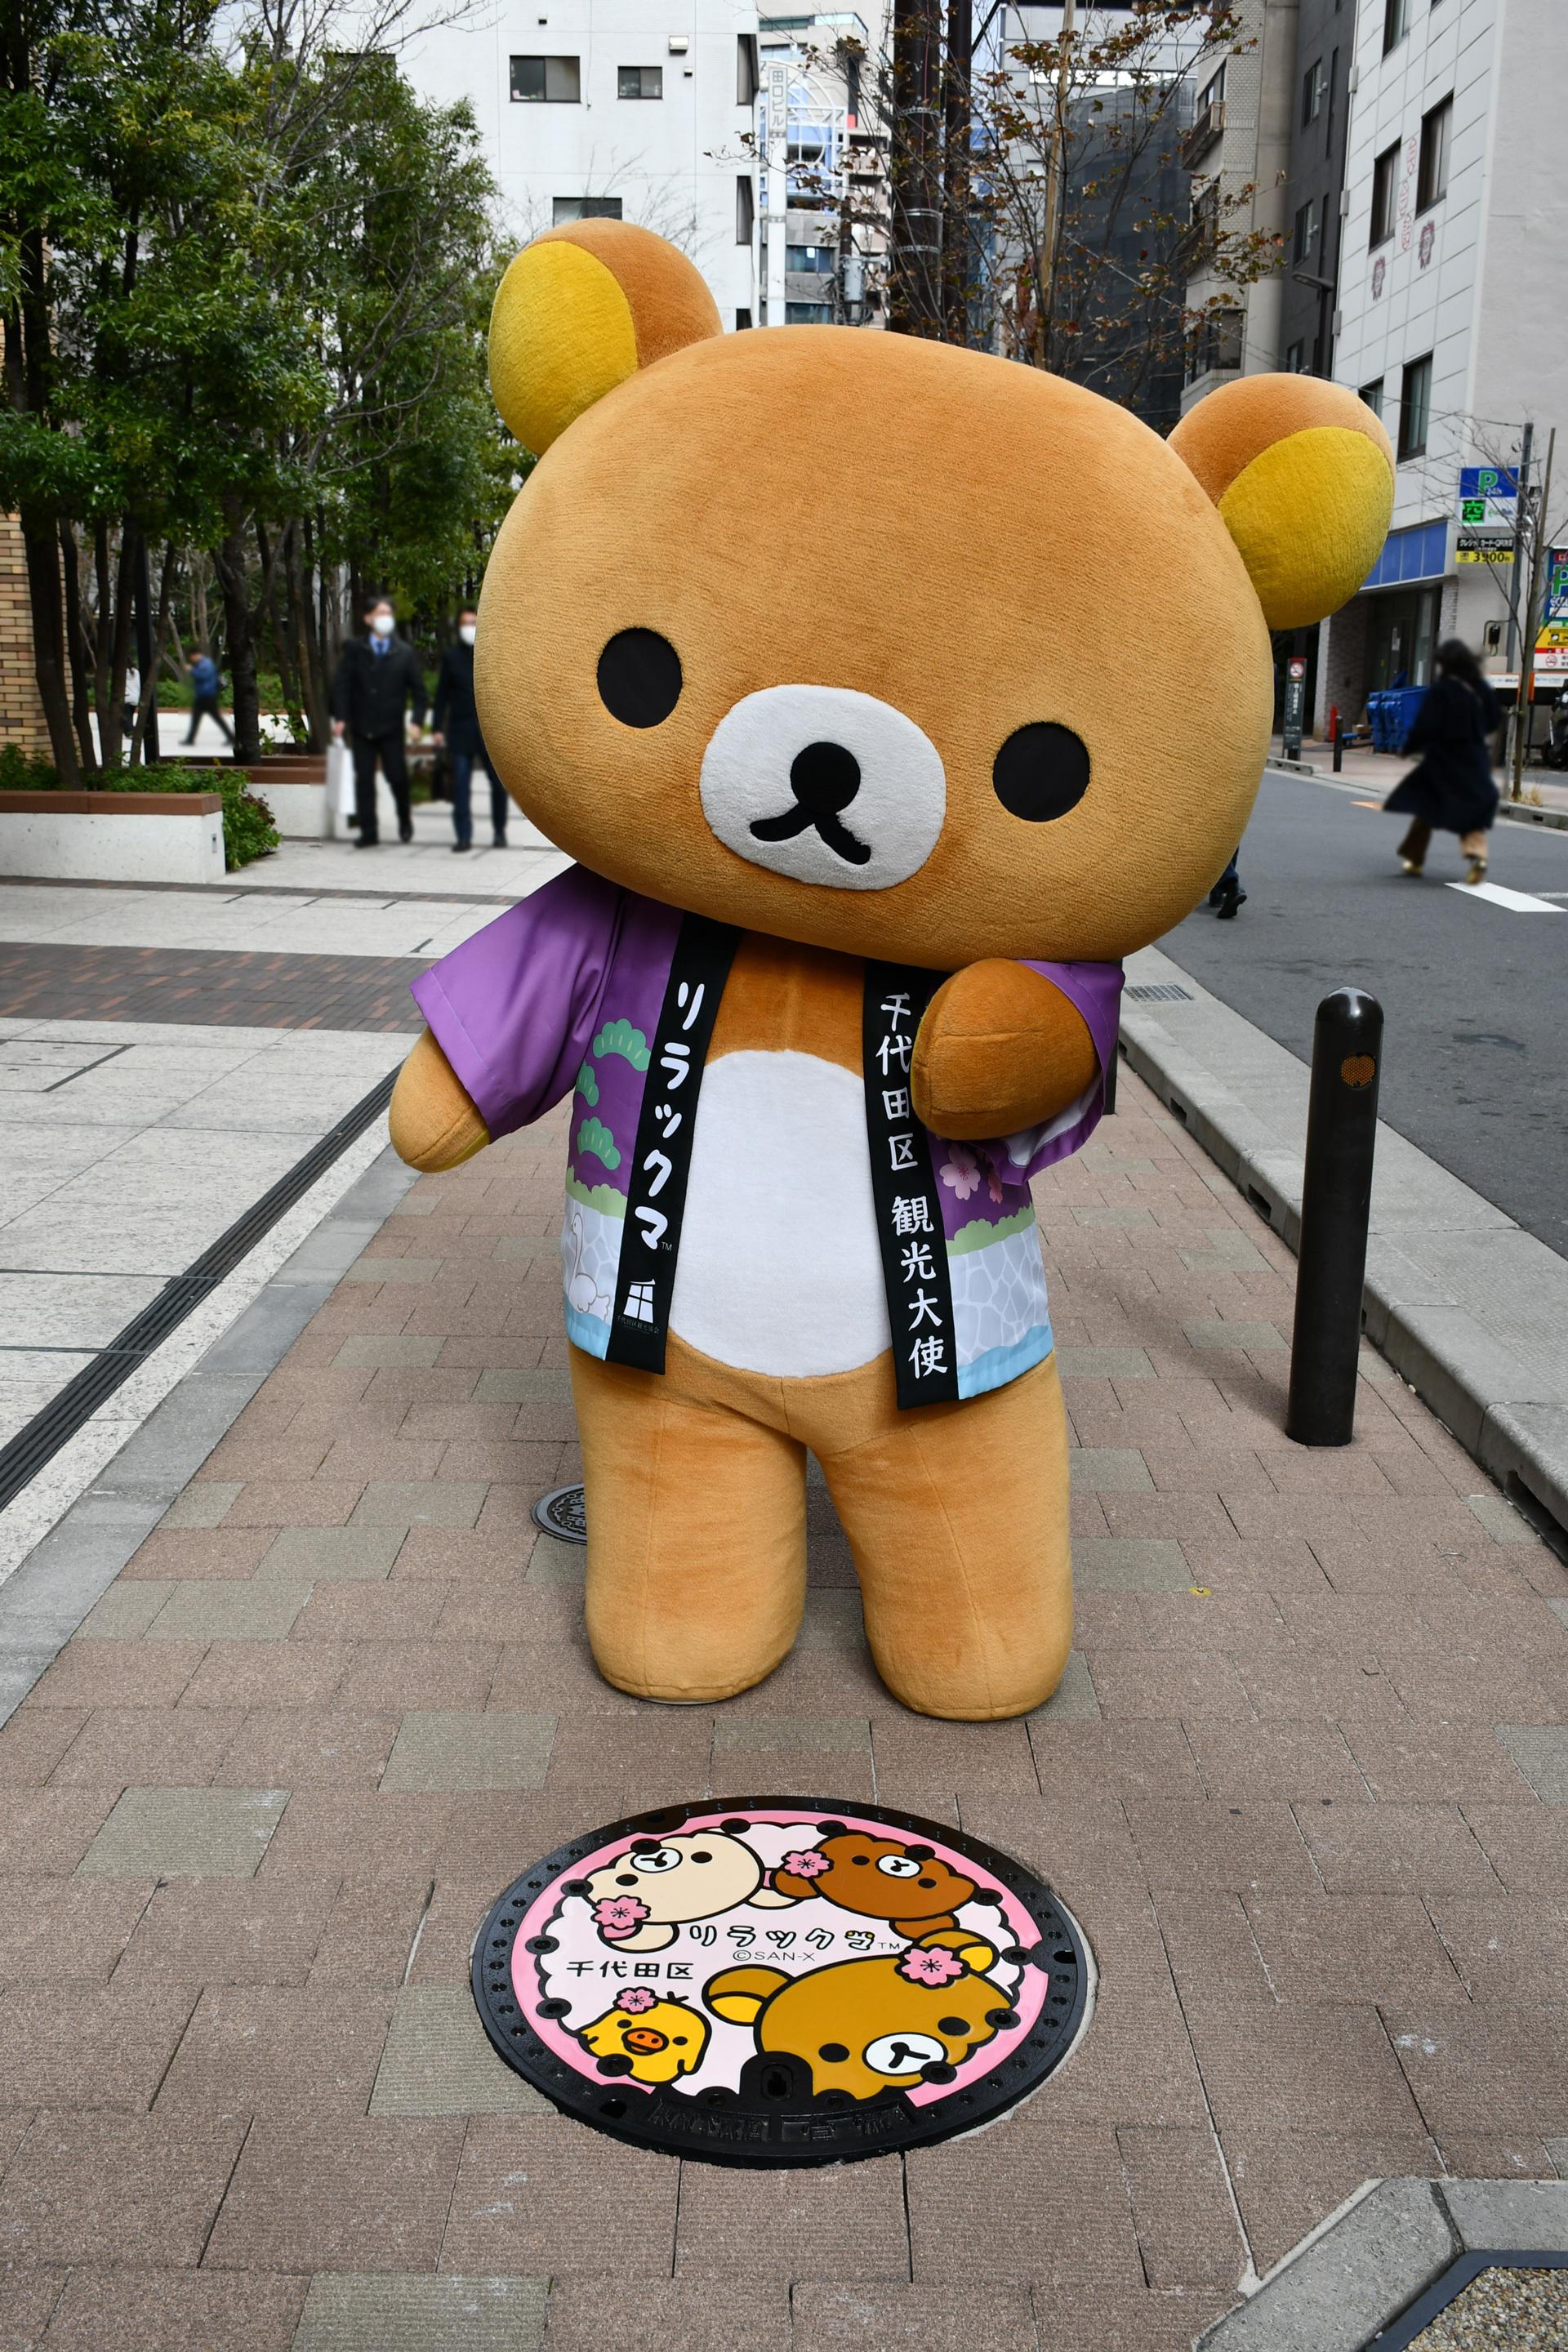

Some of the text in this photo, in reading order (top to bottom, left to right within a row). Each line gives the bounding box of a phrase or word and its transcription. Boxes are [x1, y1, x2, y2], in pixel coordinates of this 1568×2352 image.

[773, 70, 784, 126] 田口ビル
[1477, 470, 1499, 497] P
[1462, 499, 1486, 523] 空
[635, 982, 706, 1250] リラックマ
[875, 992, 948, 1379] 千代田区 観光大使
[688, 1925, 876, 1951] リラックマ
[566, 1960, 694, 1980] 千代田区
